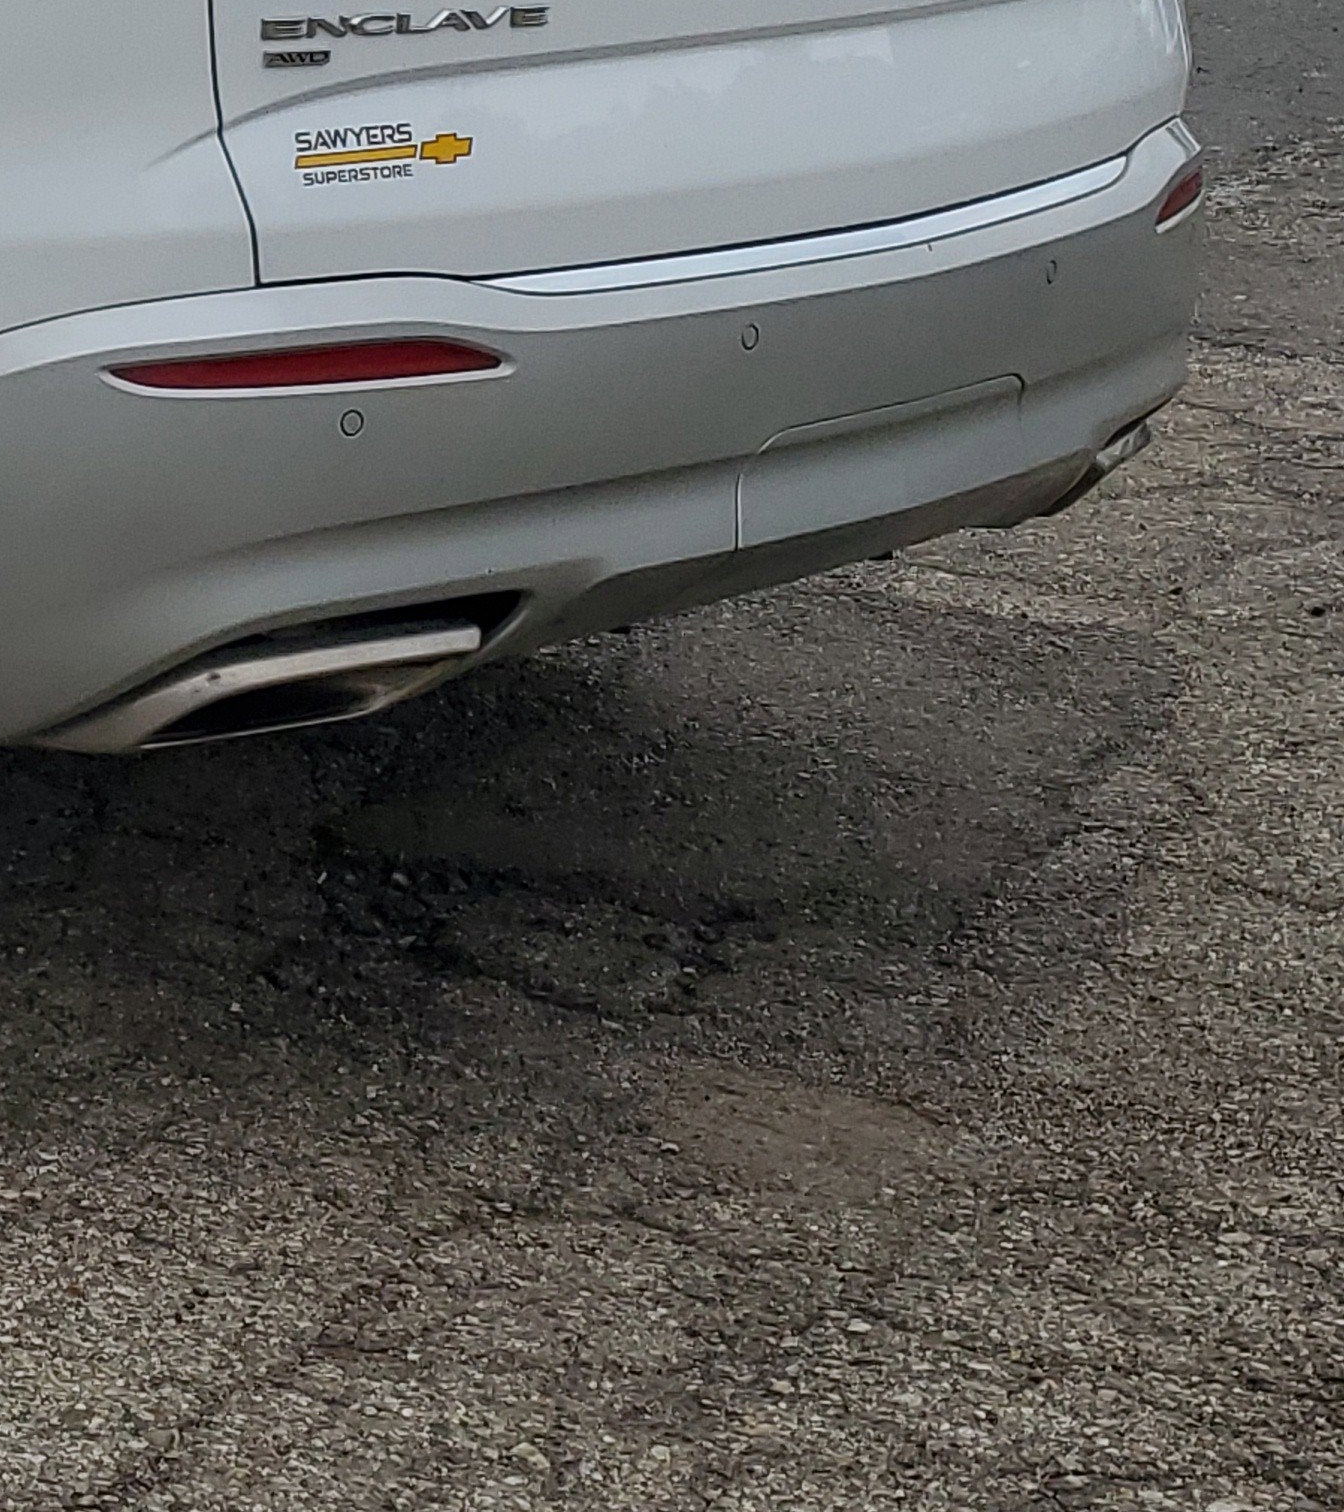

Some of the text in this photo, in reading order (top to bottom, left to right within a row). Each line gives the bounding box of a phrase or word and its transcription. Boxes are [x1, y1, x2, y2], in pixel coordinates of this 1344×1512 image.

[261, 4, 550, 39] ENCLAVE
[266, 51, 329, 65] AWD
[294, 123, 412, 152] SAWYERS
[302, 163, 413, 186] SUPERSTORE
